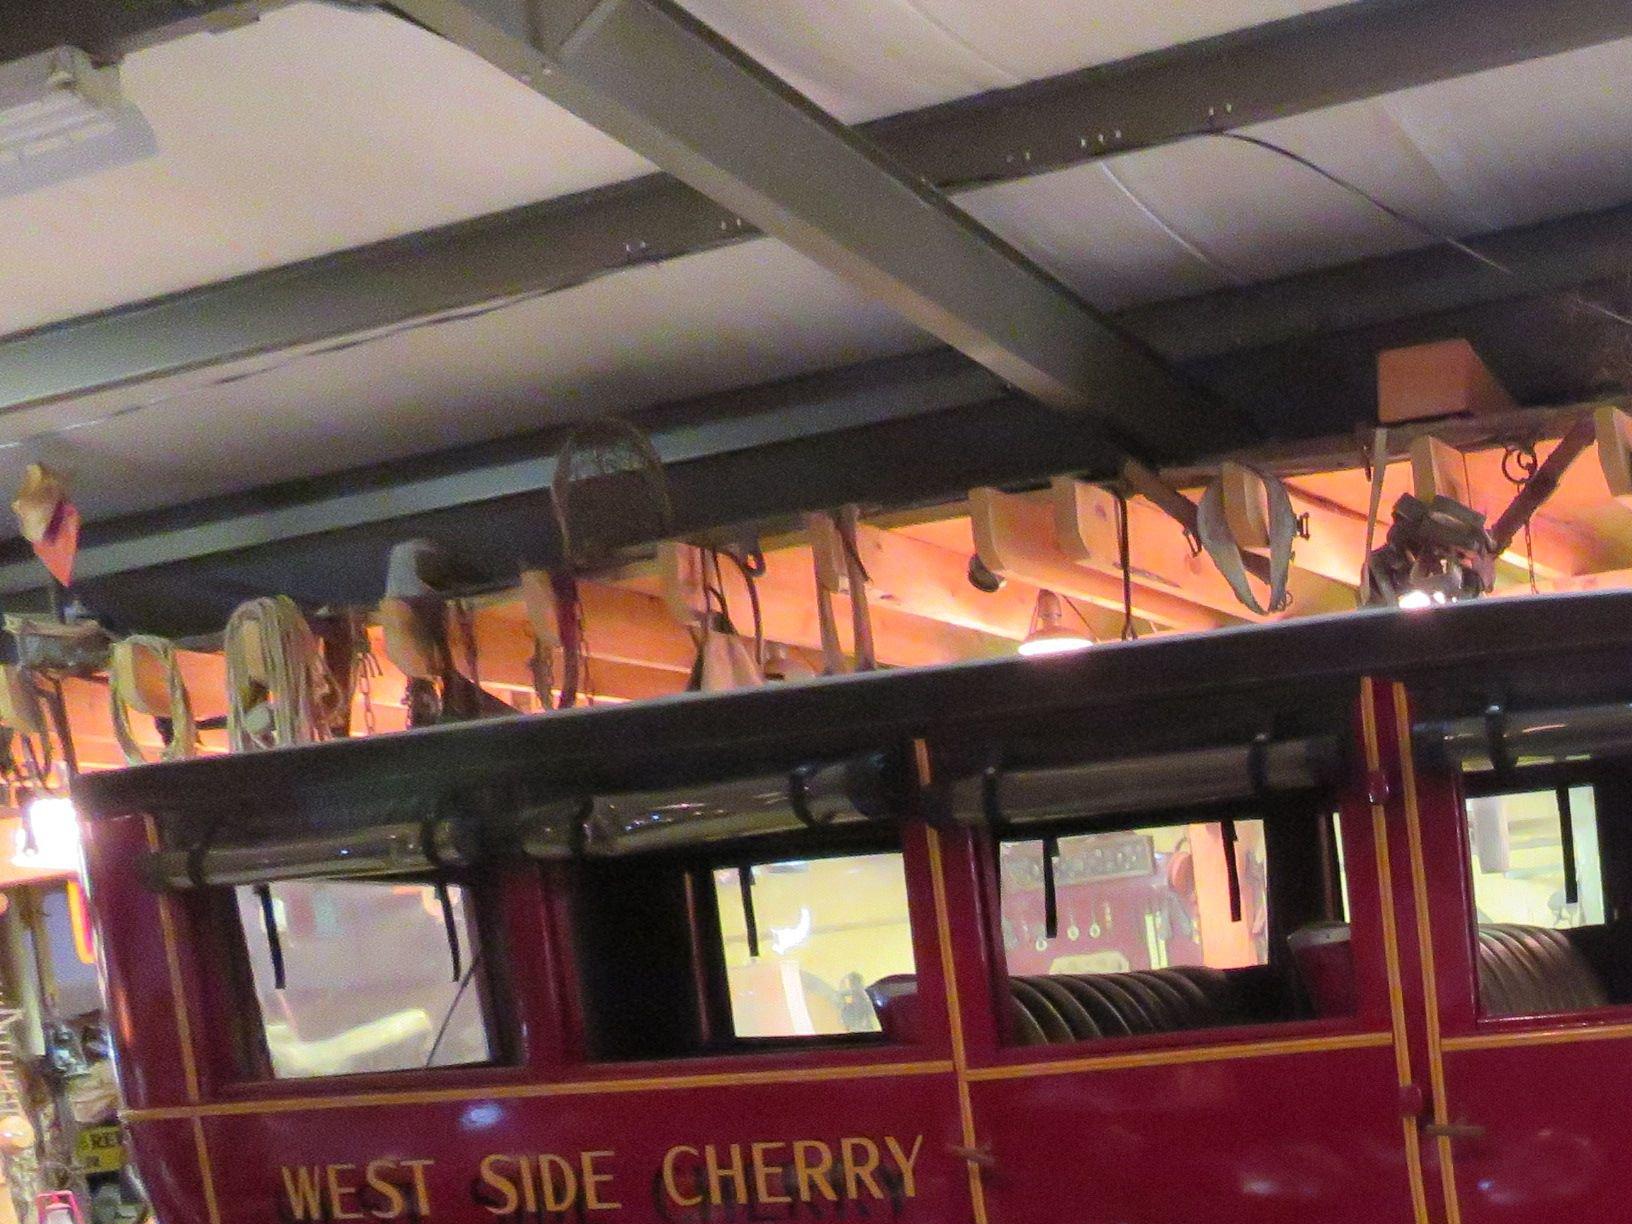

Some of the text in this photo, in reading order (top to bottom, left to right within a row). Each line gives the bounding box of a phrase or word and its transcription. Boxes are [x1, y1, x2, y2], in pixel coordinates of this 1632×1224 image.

[281, 1134, 924, 1221] WEST SIDE CHERRY
